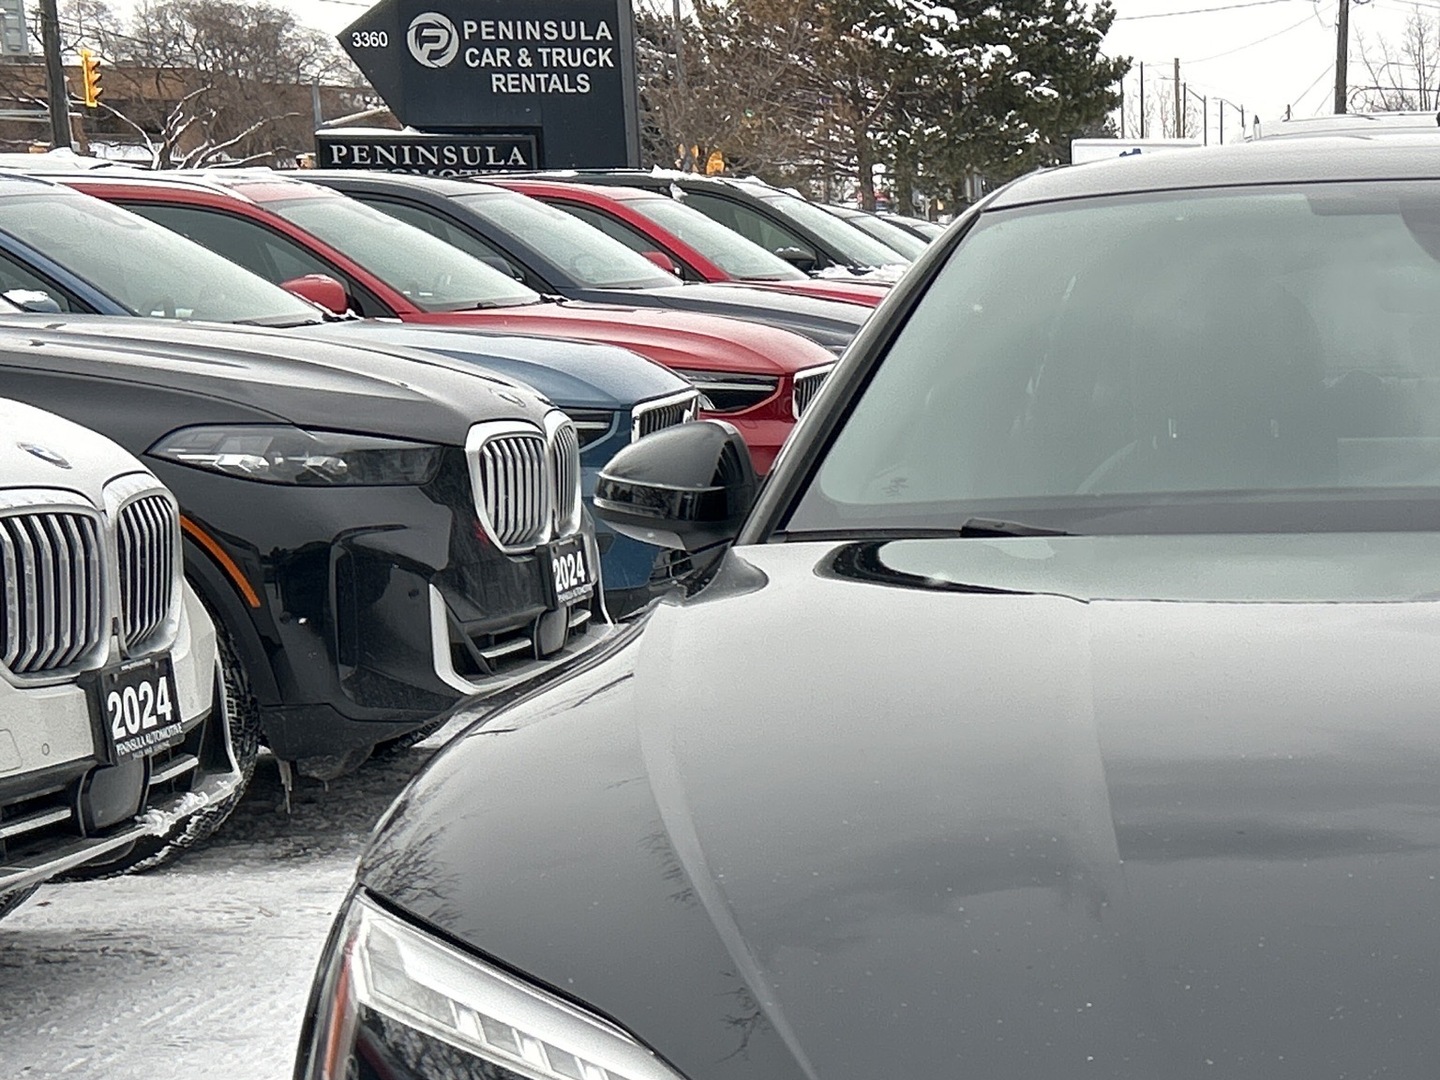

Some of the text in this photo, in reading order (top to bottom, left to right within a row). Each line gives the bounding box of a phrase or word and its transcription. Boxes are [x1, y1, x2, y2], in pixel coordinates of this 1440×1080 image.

[352, 32, 388, 48] 3360
[463, 20, 613, 41] PENINSULA
[464, 48, 614, 67] CAR & TRUCK
[491, 73, 591, 93] RENTALS
[330, 145, 527, 166] PENINSULA
[552, 551, 586, 592] 2024
[107, 676, 173, 740] 2024
